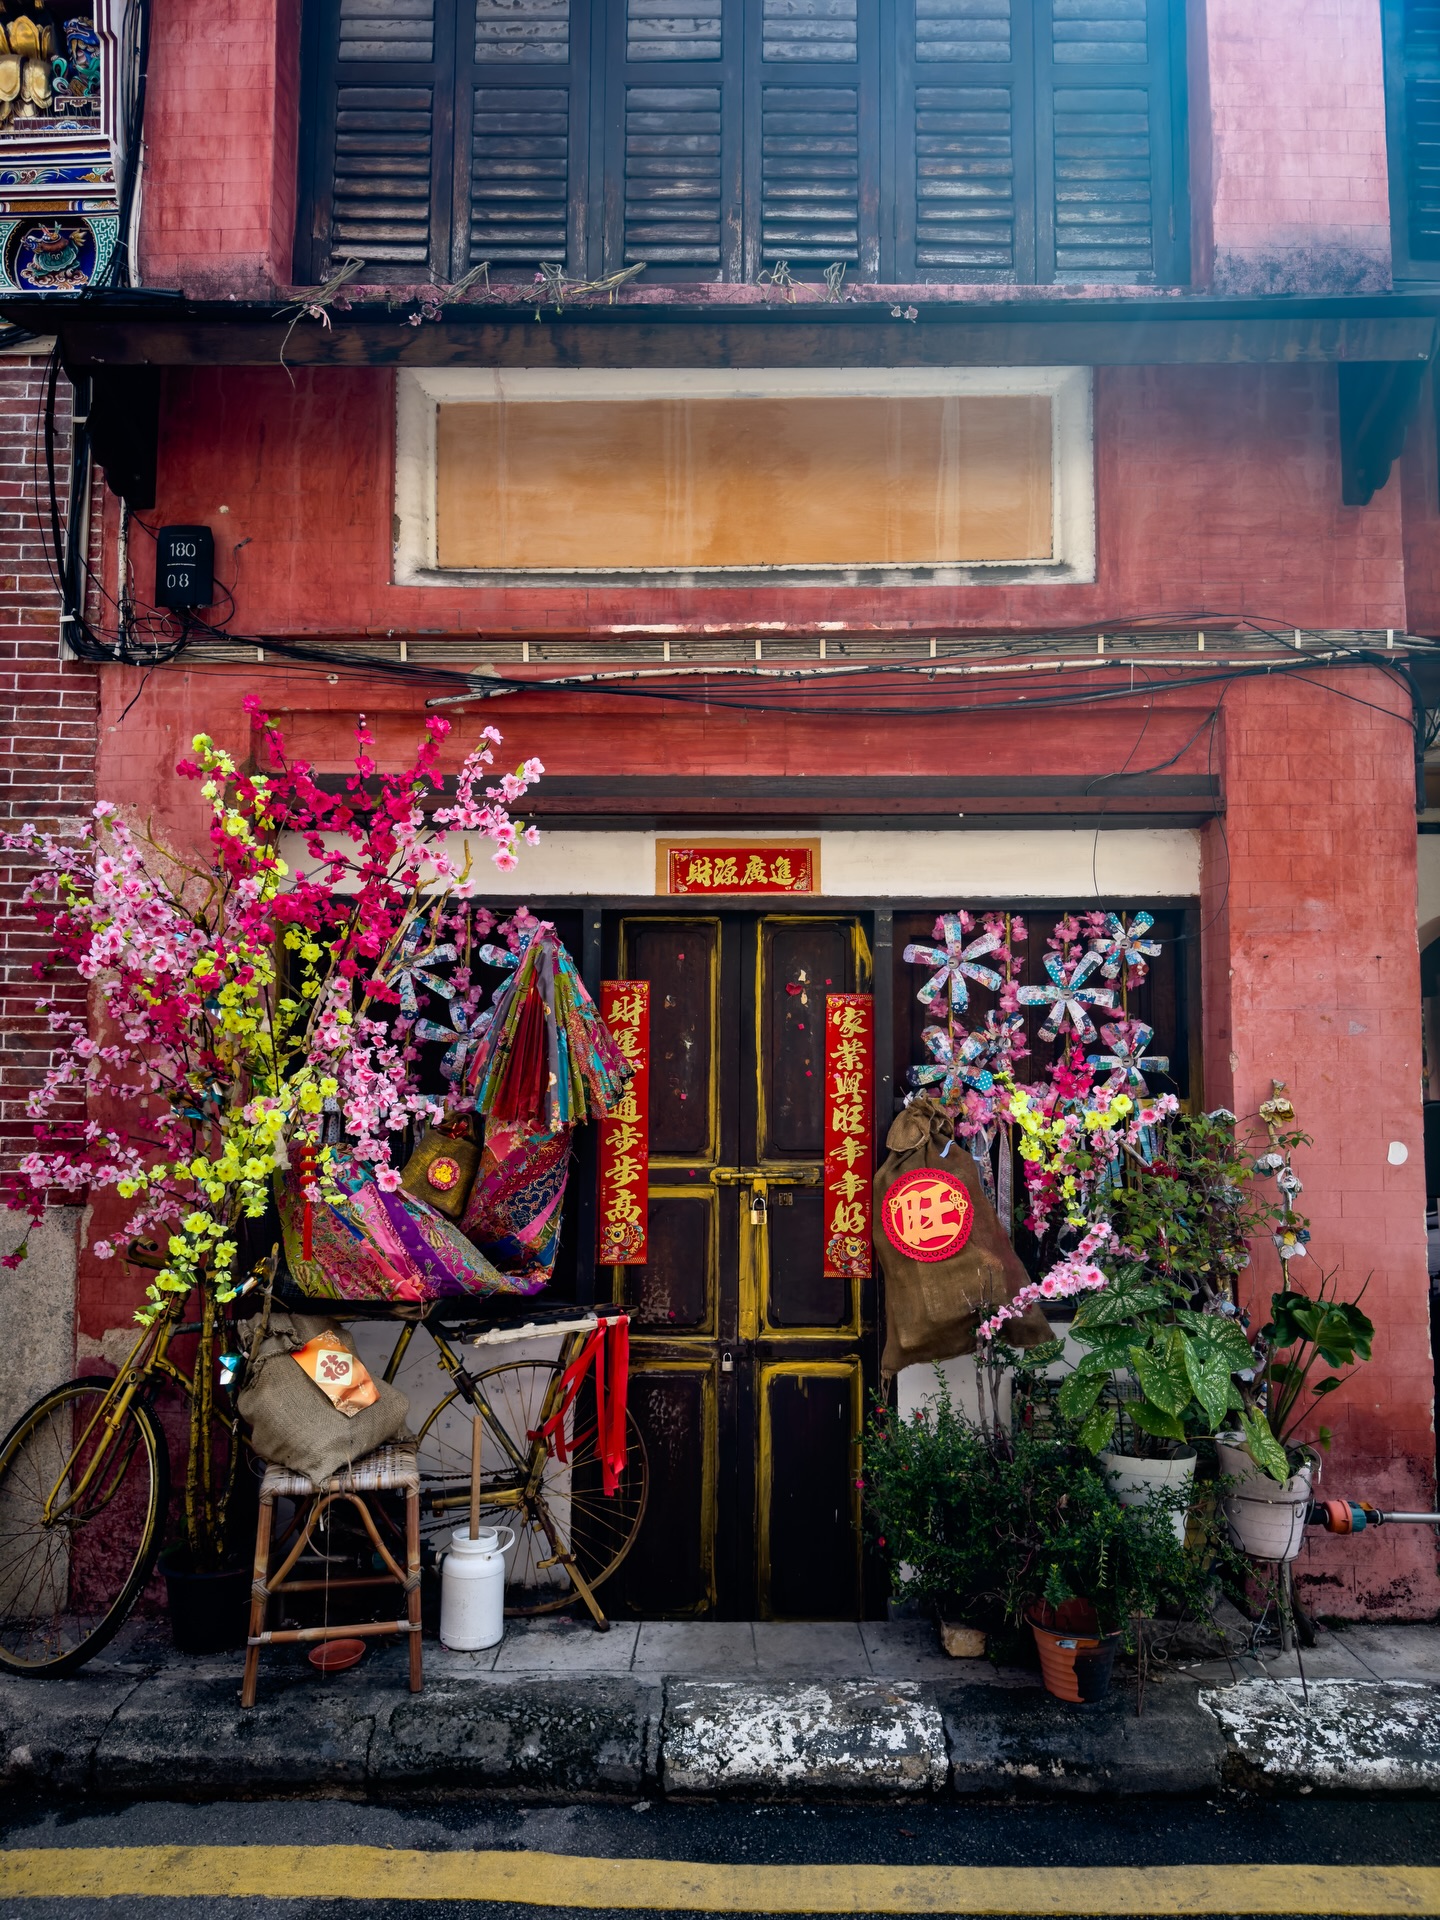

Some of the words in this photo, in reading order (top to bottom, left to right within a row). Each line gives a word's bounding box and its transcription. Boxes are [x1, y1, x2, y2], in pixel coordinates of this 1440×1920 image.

[170, 542, 196, 557] 180
[686, 854, 796, 888] 財源廣進
[829, 1006, 869, 1234] 家業興旺年年好
[899, 1183, 961, 1246] 旺
